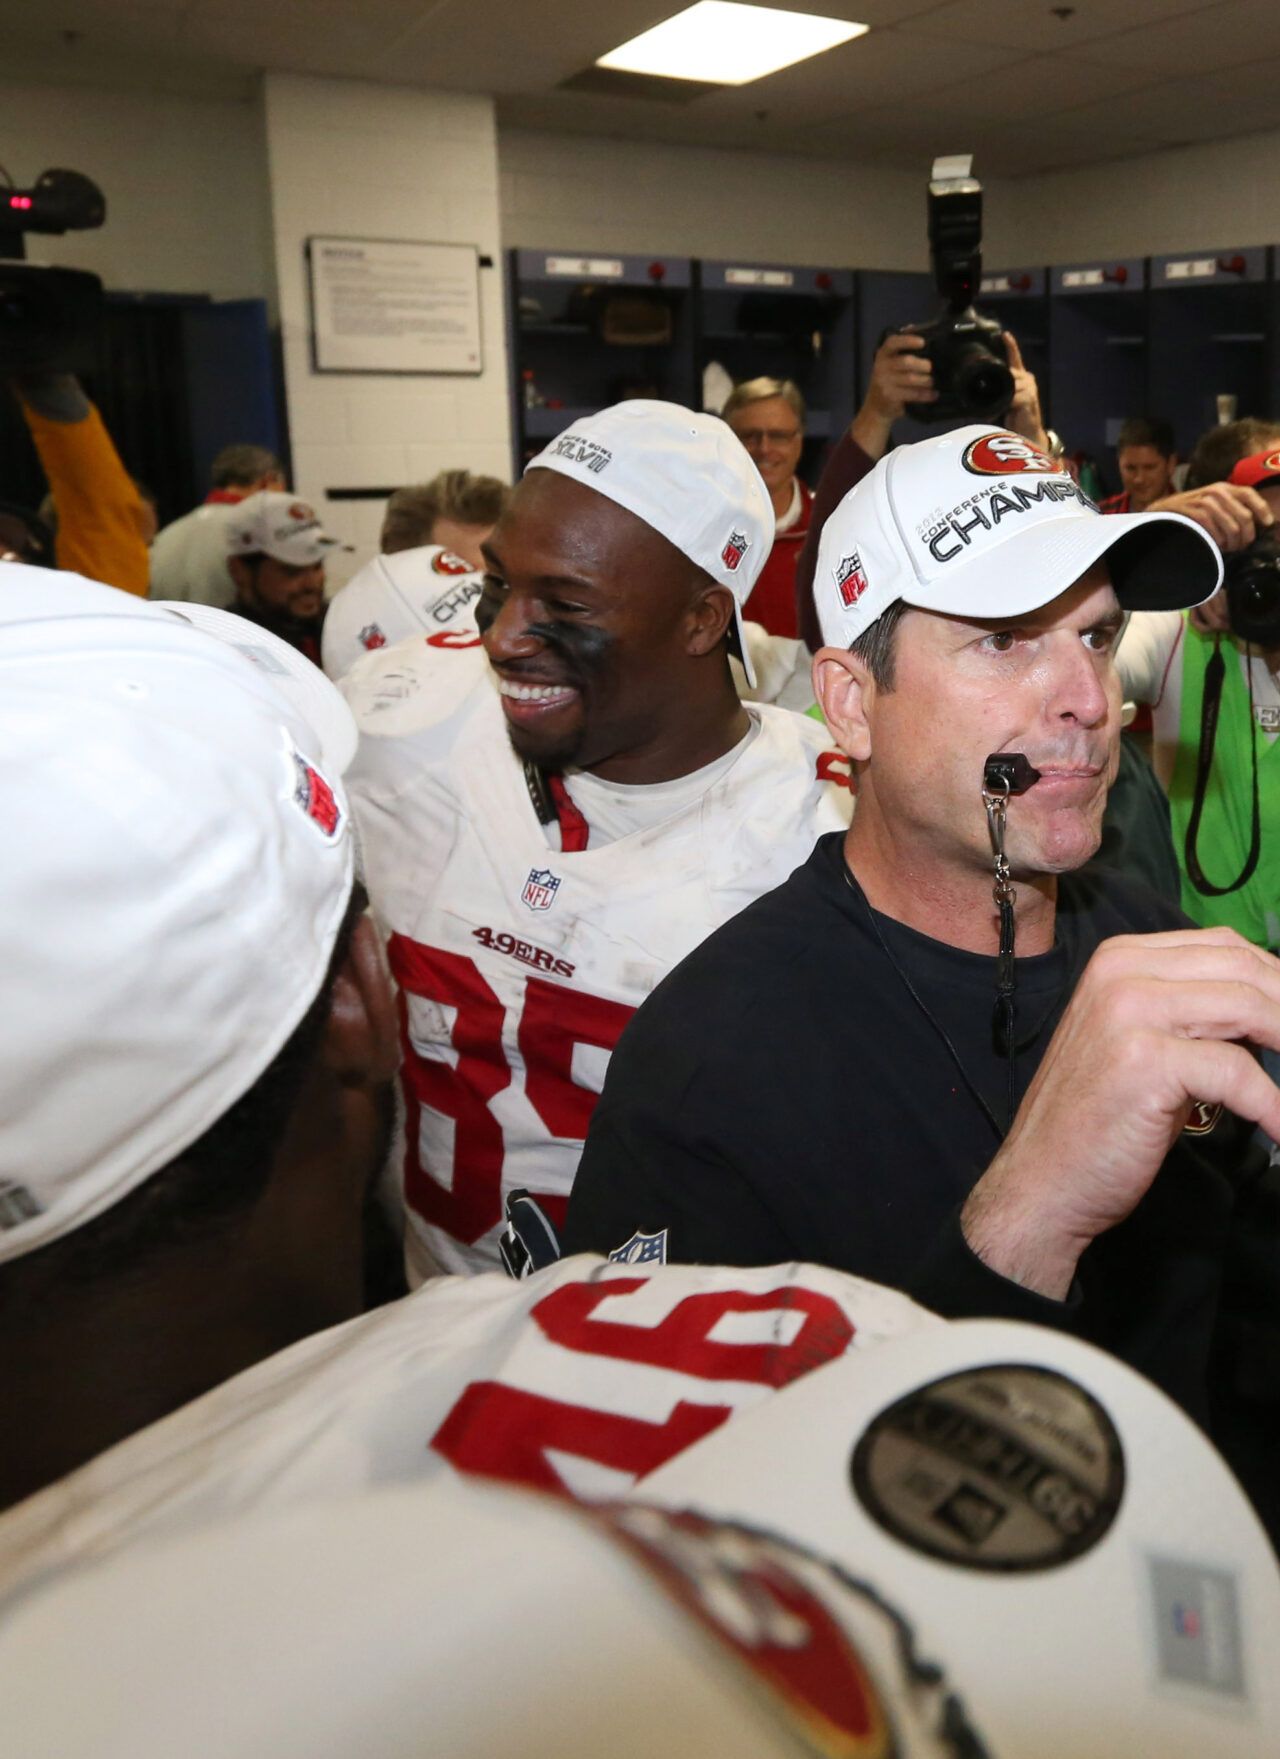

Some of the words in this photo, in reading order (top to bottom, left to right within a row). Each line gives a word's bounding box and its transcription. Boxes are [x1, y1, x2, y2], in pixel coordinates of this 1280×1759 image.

[550, 440, 610, 473] XLVII
[588, 442, 612, 460] BOWL
[922, 482, 1008, 543] CONFERENCE
[839, 572, 867, 607] NFL
[523, 884, 551, 911] NFL
[472, 926, 576, 978] 49ERS
